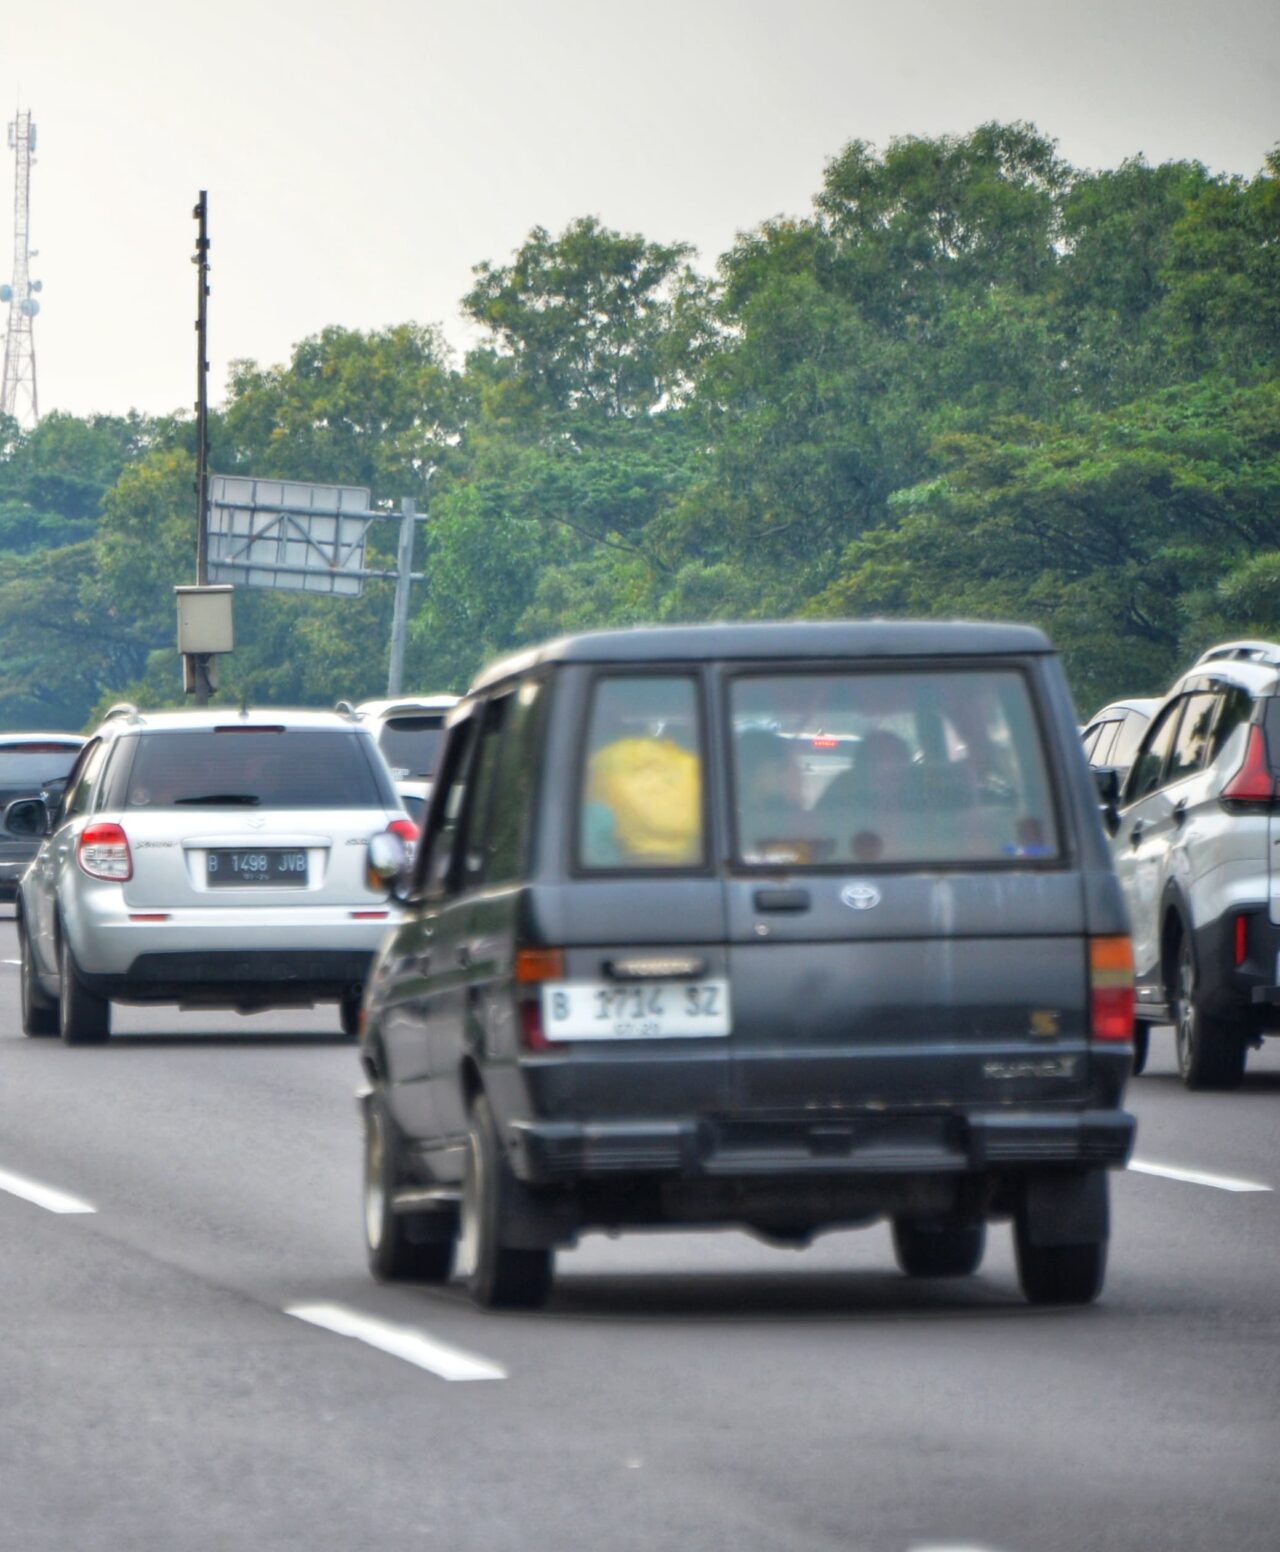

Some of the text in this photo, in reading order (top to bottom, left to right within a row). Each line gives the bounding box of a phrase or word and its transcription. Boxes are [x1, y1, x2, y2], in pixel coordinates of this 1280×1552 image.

[208, 854, 307, 872] B 1498 JVB
[552, 991, 569, 1021] B
